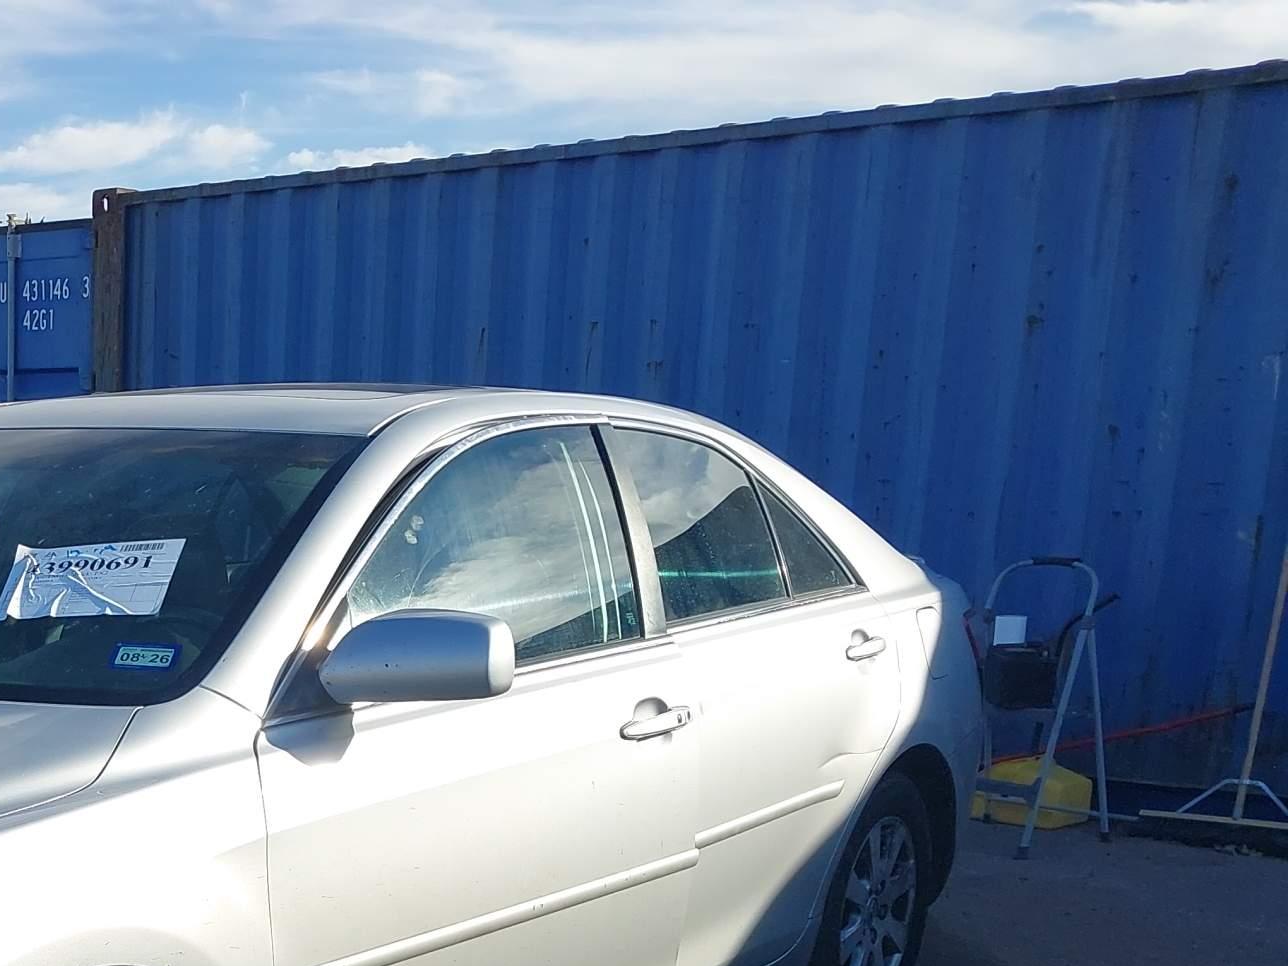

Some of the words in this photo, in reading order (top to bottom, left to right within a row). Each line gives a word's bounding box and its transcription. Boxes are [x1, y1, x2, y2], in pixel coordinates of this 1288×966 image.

[23, 279, 69, 301] 431146
[82, 276, 90, 297] 3
[23, 309, 54, 330] 42G1
[120, 652, 141, 663] 08
[148, 653, 171, 664] 26
